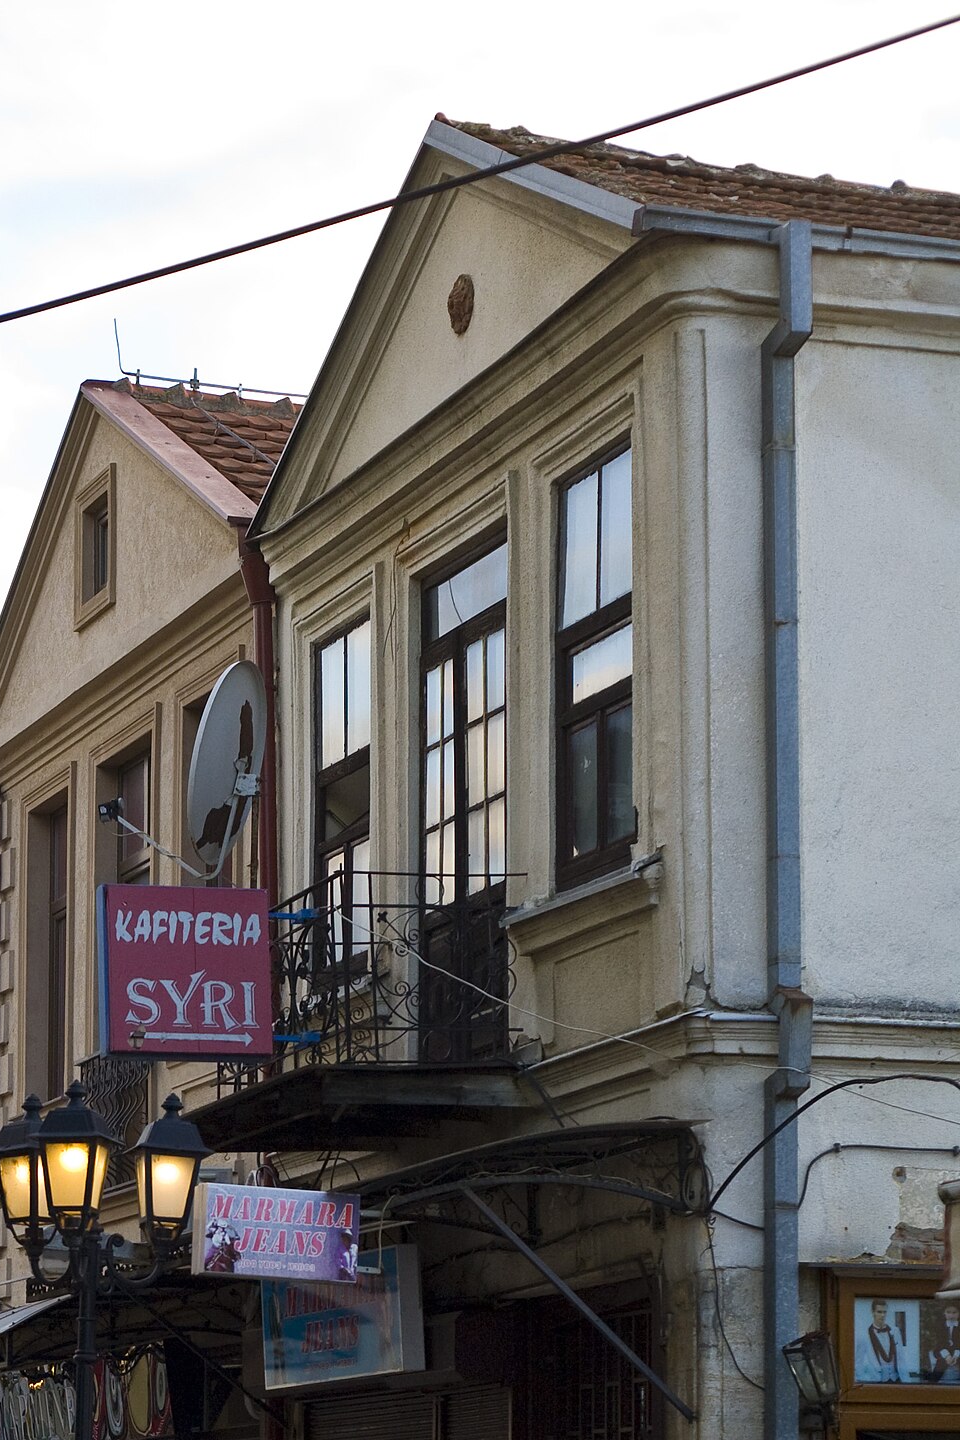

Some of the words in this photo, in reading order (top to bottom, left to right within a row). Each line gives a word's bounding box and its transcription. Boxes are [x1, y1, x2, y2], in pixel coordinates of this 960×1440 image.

[115, 908, 261, 946] KAFITERIA
[124, 969, 260, 1032] SYRI
[210, 1193, 354, 1229] MARMARA
[233, 1227, 327, 1258] JEANS
